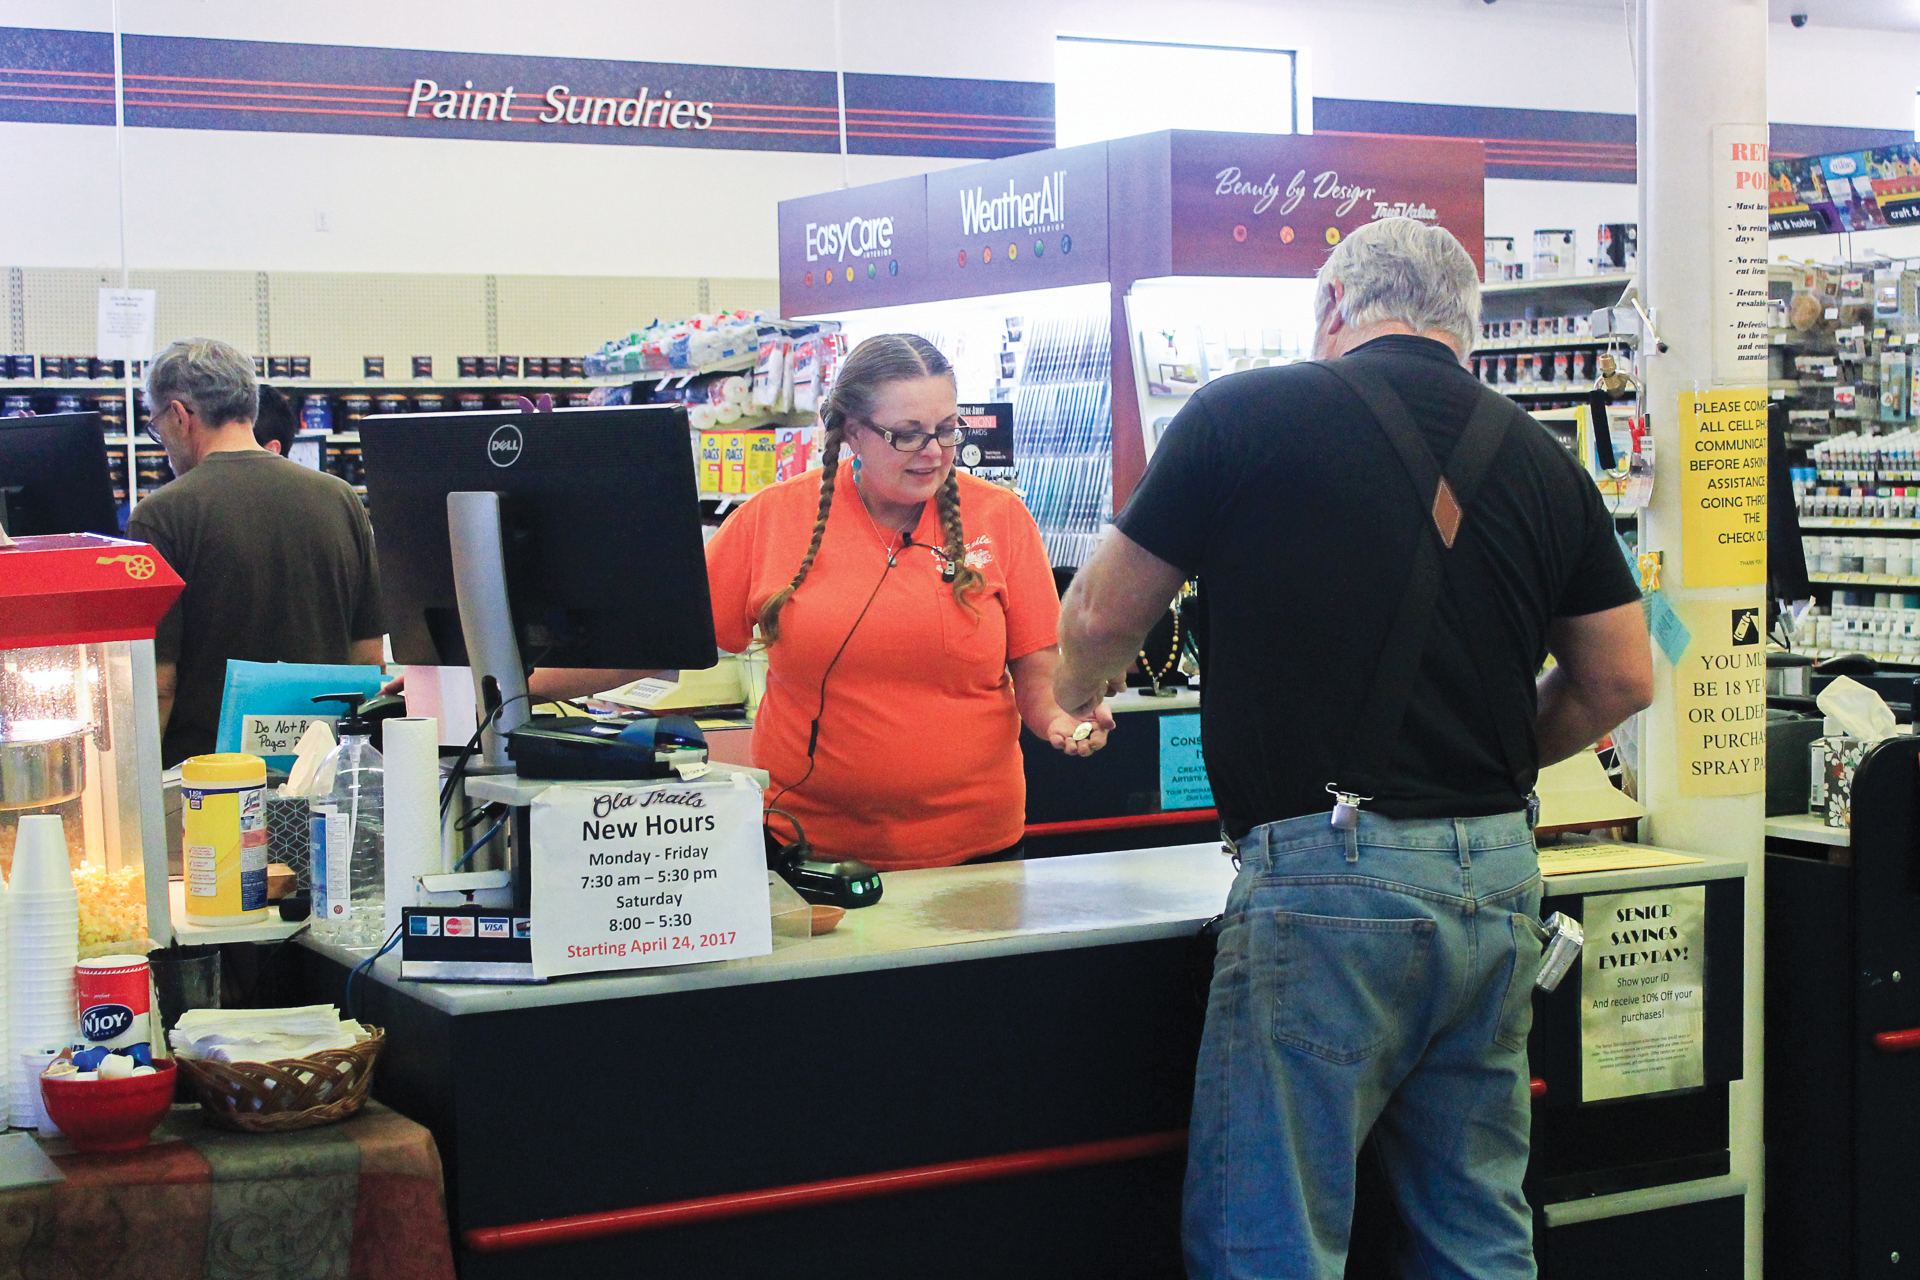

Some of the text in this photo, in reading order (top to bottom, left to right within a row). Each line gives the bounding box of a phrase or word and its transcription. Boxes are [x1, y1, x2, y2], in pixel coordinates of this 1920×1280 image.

[407, 79, 714, 130] Paint Sundries
[1731, 143, 1768, 162] RET
[1735, 171, 1768, 190] POL
[1216, 167, 1375, 217] Beauty by Design
[960, 170, 1066, 236] WeatherAll
[1891, 207, 1911, 219] craft
[1790, 217, 1817, 229] hobby
[806, 216, 894, 262] EasyCare
[1735, 235, 1754, 244] days
[1736, 256, 1747, 264] No
[1694, 400, 1767, 414] PLEASE COMP
[1700, 419, 1767, 433] ALL CELL PHO
[492, 440, 518, 451] DELL
[1695, 438, 1767, 452] COMMUNICAT
[703, 448, 720, 460] RAGS
[725, 448, 743, 460] RAGS
[1690, 459, 1740, 471] BEFORE
[1708, 476, 1765, 489] ASSISTANCE
[1701, 496, 1743, 509] GOING
[1743, 512, 1760, 523] THE
[1718, 531, 1755, 544] CHECK
[1701, 651, 1766, 670] YOU MUS
[1693, 678, 1766, 696] BE 18 YEA
[1689, 704, 1765, 723] OR OLDER
[254, 720, 269, 734] Do
[275, 720, 297, 734] Not
[259, 734, 286, 752] Pages
[1171, 737, 1202, 746] CONS
[1692, 759, 1750, 775] SPRAY
[593, 790, 706, 818] Old Trails
[583, 814, 715, 841] New Hours
[589, 850, 651, 866] Monday
[665, 845, 709, 860] Friday
[581, 875, 613, 889] 7:30
[618, 876, 640, 887] am
[658, 868, 689, 883] 5:30
[693, 868, 718, 886] pm
[616, 892, 683, 909] Saturday
[1617, 904, 1673, 923] SENIOR
[484, 923, 504, 932] VISA
[609, 917, 641, 932] 8:00
[659, 913, 692, 928] 5:30
[1611, 926, 1678, 946] SAVINGS
[567, 932, 737, 958] Starting April 24, 2017
[1599, 947, 1689, 970] EVERYDAY!
[1617, 973, 1670, 988] Show your ID
[1593, 989, 1693, 1009] And receive 10% Off your
[1621, 1009, 1665, 1025] purchases!
